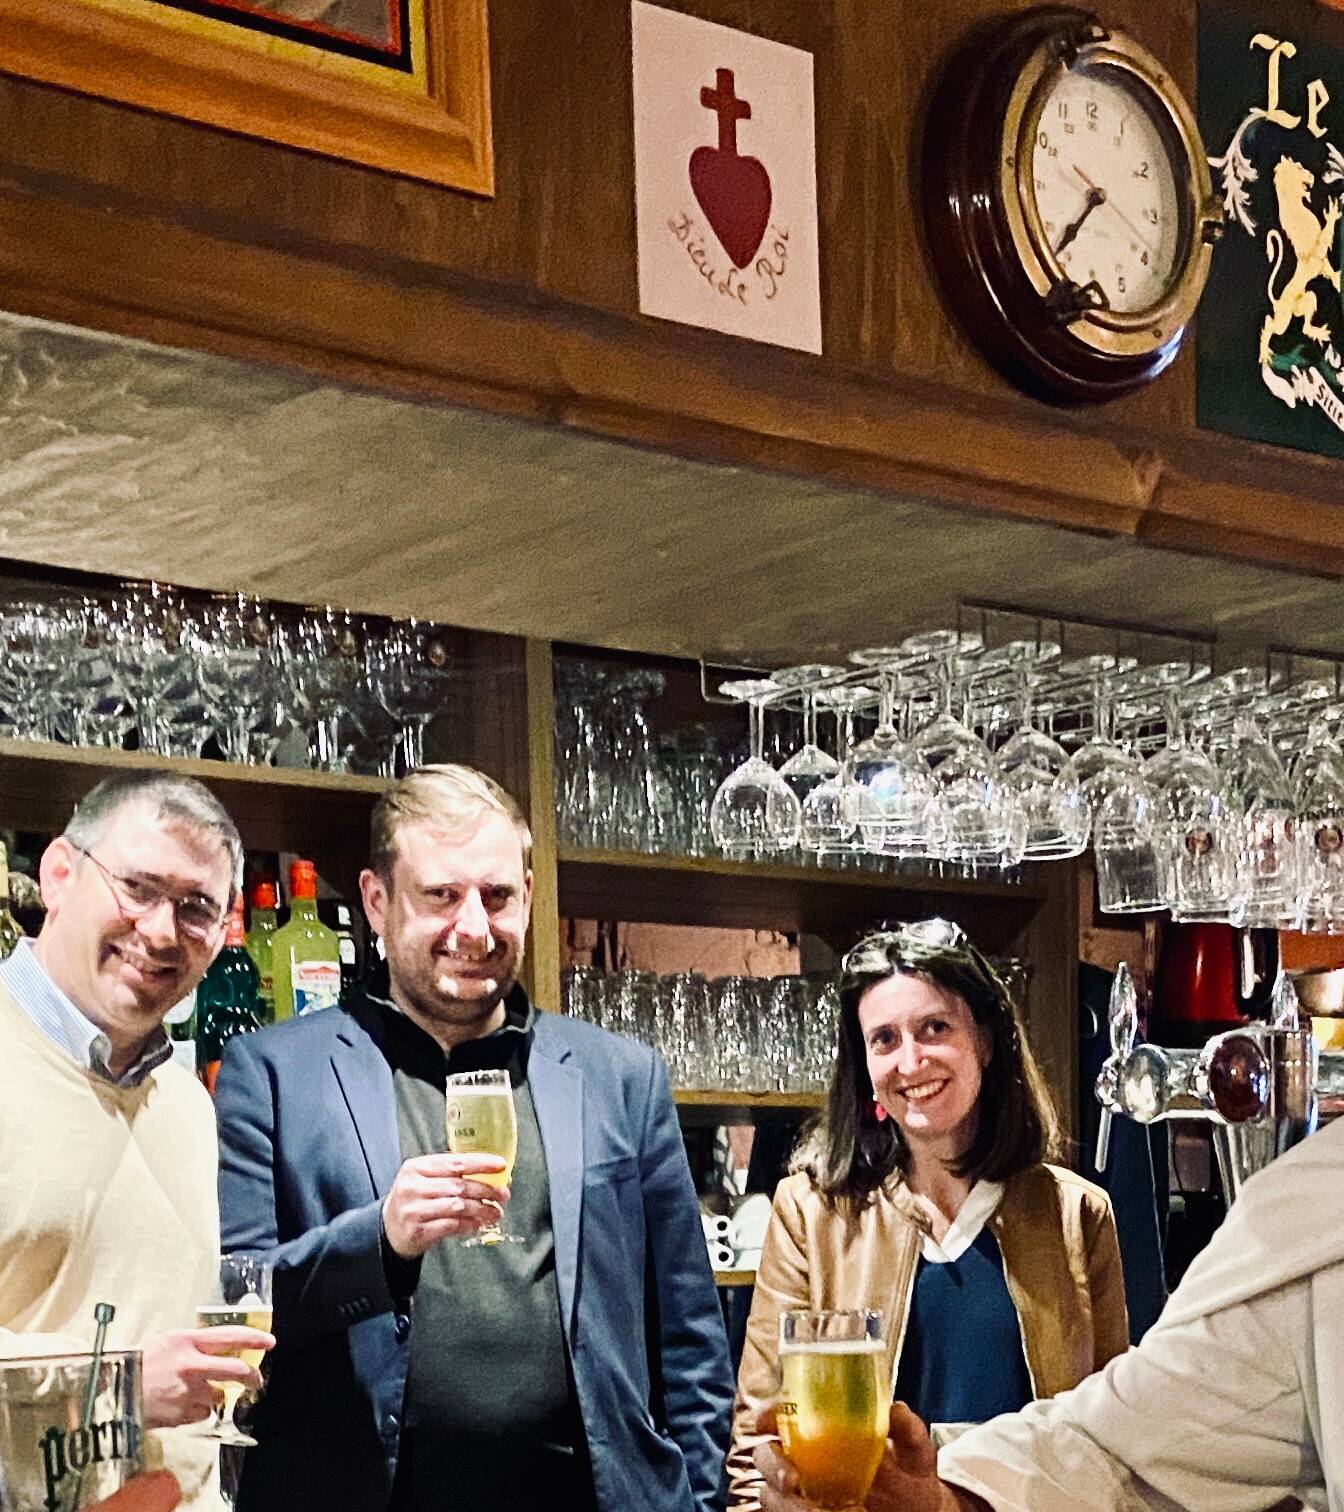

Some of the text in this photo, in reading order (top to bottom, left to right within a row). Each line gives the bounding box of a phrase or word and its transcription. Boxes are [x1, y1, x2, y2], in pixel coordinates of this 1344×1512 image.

[1086, 102, 1099, 119] 12
[1249, 33, 1330, 139] Le
[756, 223, 790, 299] Roi
